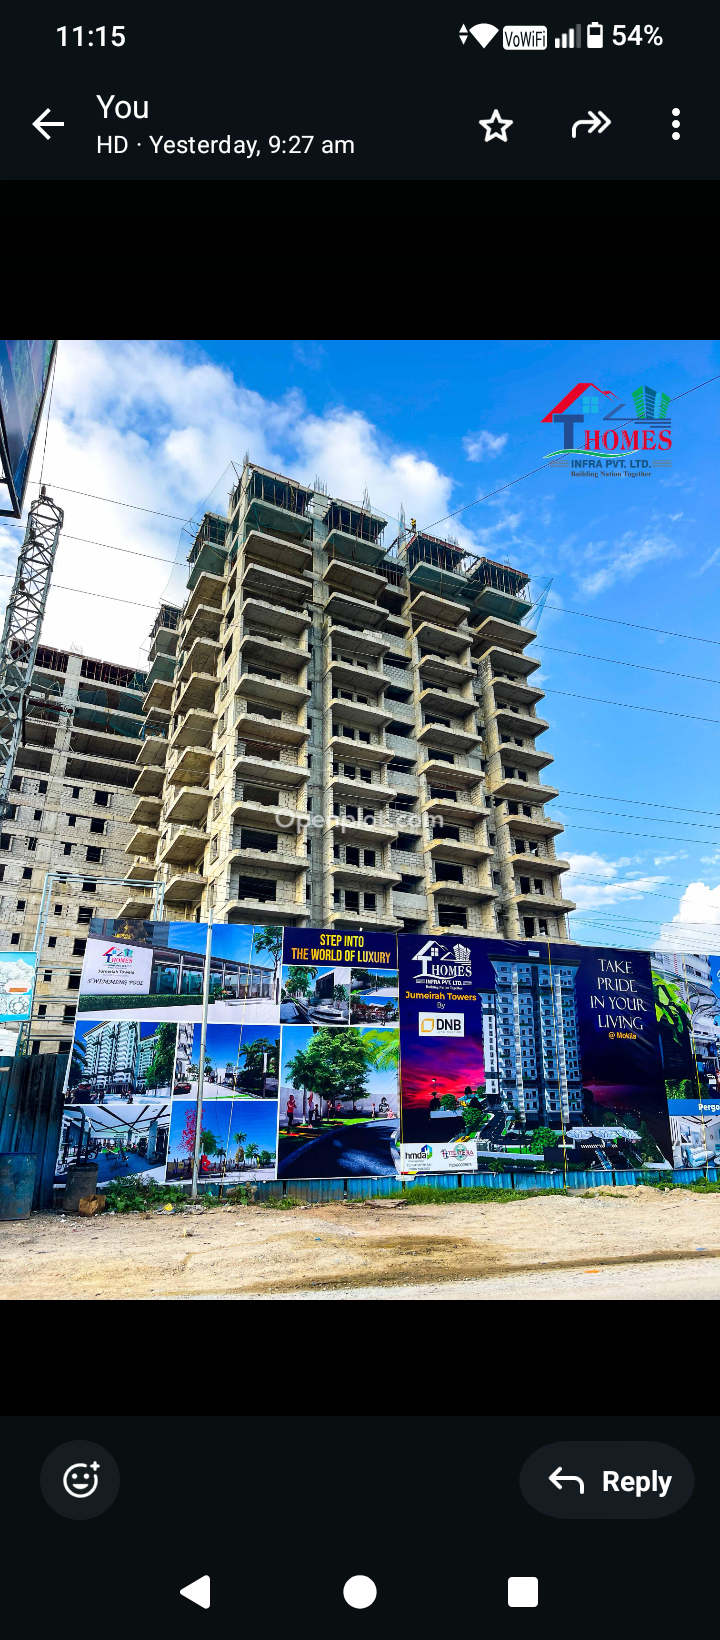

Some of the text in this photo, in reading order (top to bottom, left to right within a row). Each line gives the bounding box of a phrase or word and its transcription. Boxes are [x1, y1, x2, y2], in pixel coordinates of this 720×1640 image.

[57, 26, 126, 47] 11:15
[504, 30, 546, 48] VoWiFi
[612, 25, 663, 47] 54%
[96, 95, 149, 119] You
[97, 135, 355, 159] HD Yesterday, 9:27 am
[320, 934, 364, 947] STEP INTO
[291, 948, 391, 963] THE WORLD OF LUXURY
[597, 958, 633, 974] TAKE
[597, 977, 638, 993] PRIDE
[405, 991, 477, 1001] Jumeirah Towers
[590, 995, 647, 1012] IN YOUR
[436, 1001, 446, 1010] By
[436, 1018, 462, 1031] DNB
[597, 1014, 644, 1031] LIVING
[608, 1031, 637, 1040] @ Mokila
[698, 1103, 720, 1112] Pergo
[405, 1151, 426, 1159] hmda
[602, 1469, 673, 1498] Reply
